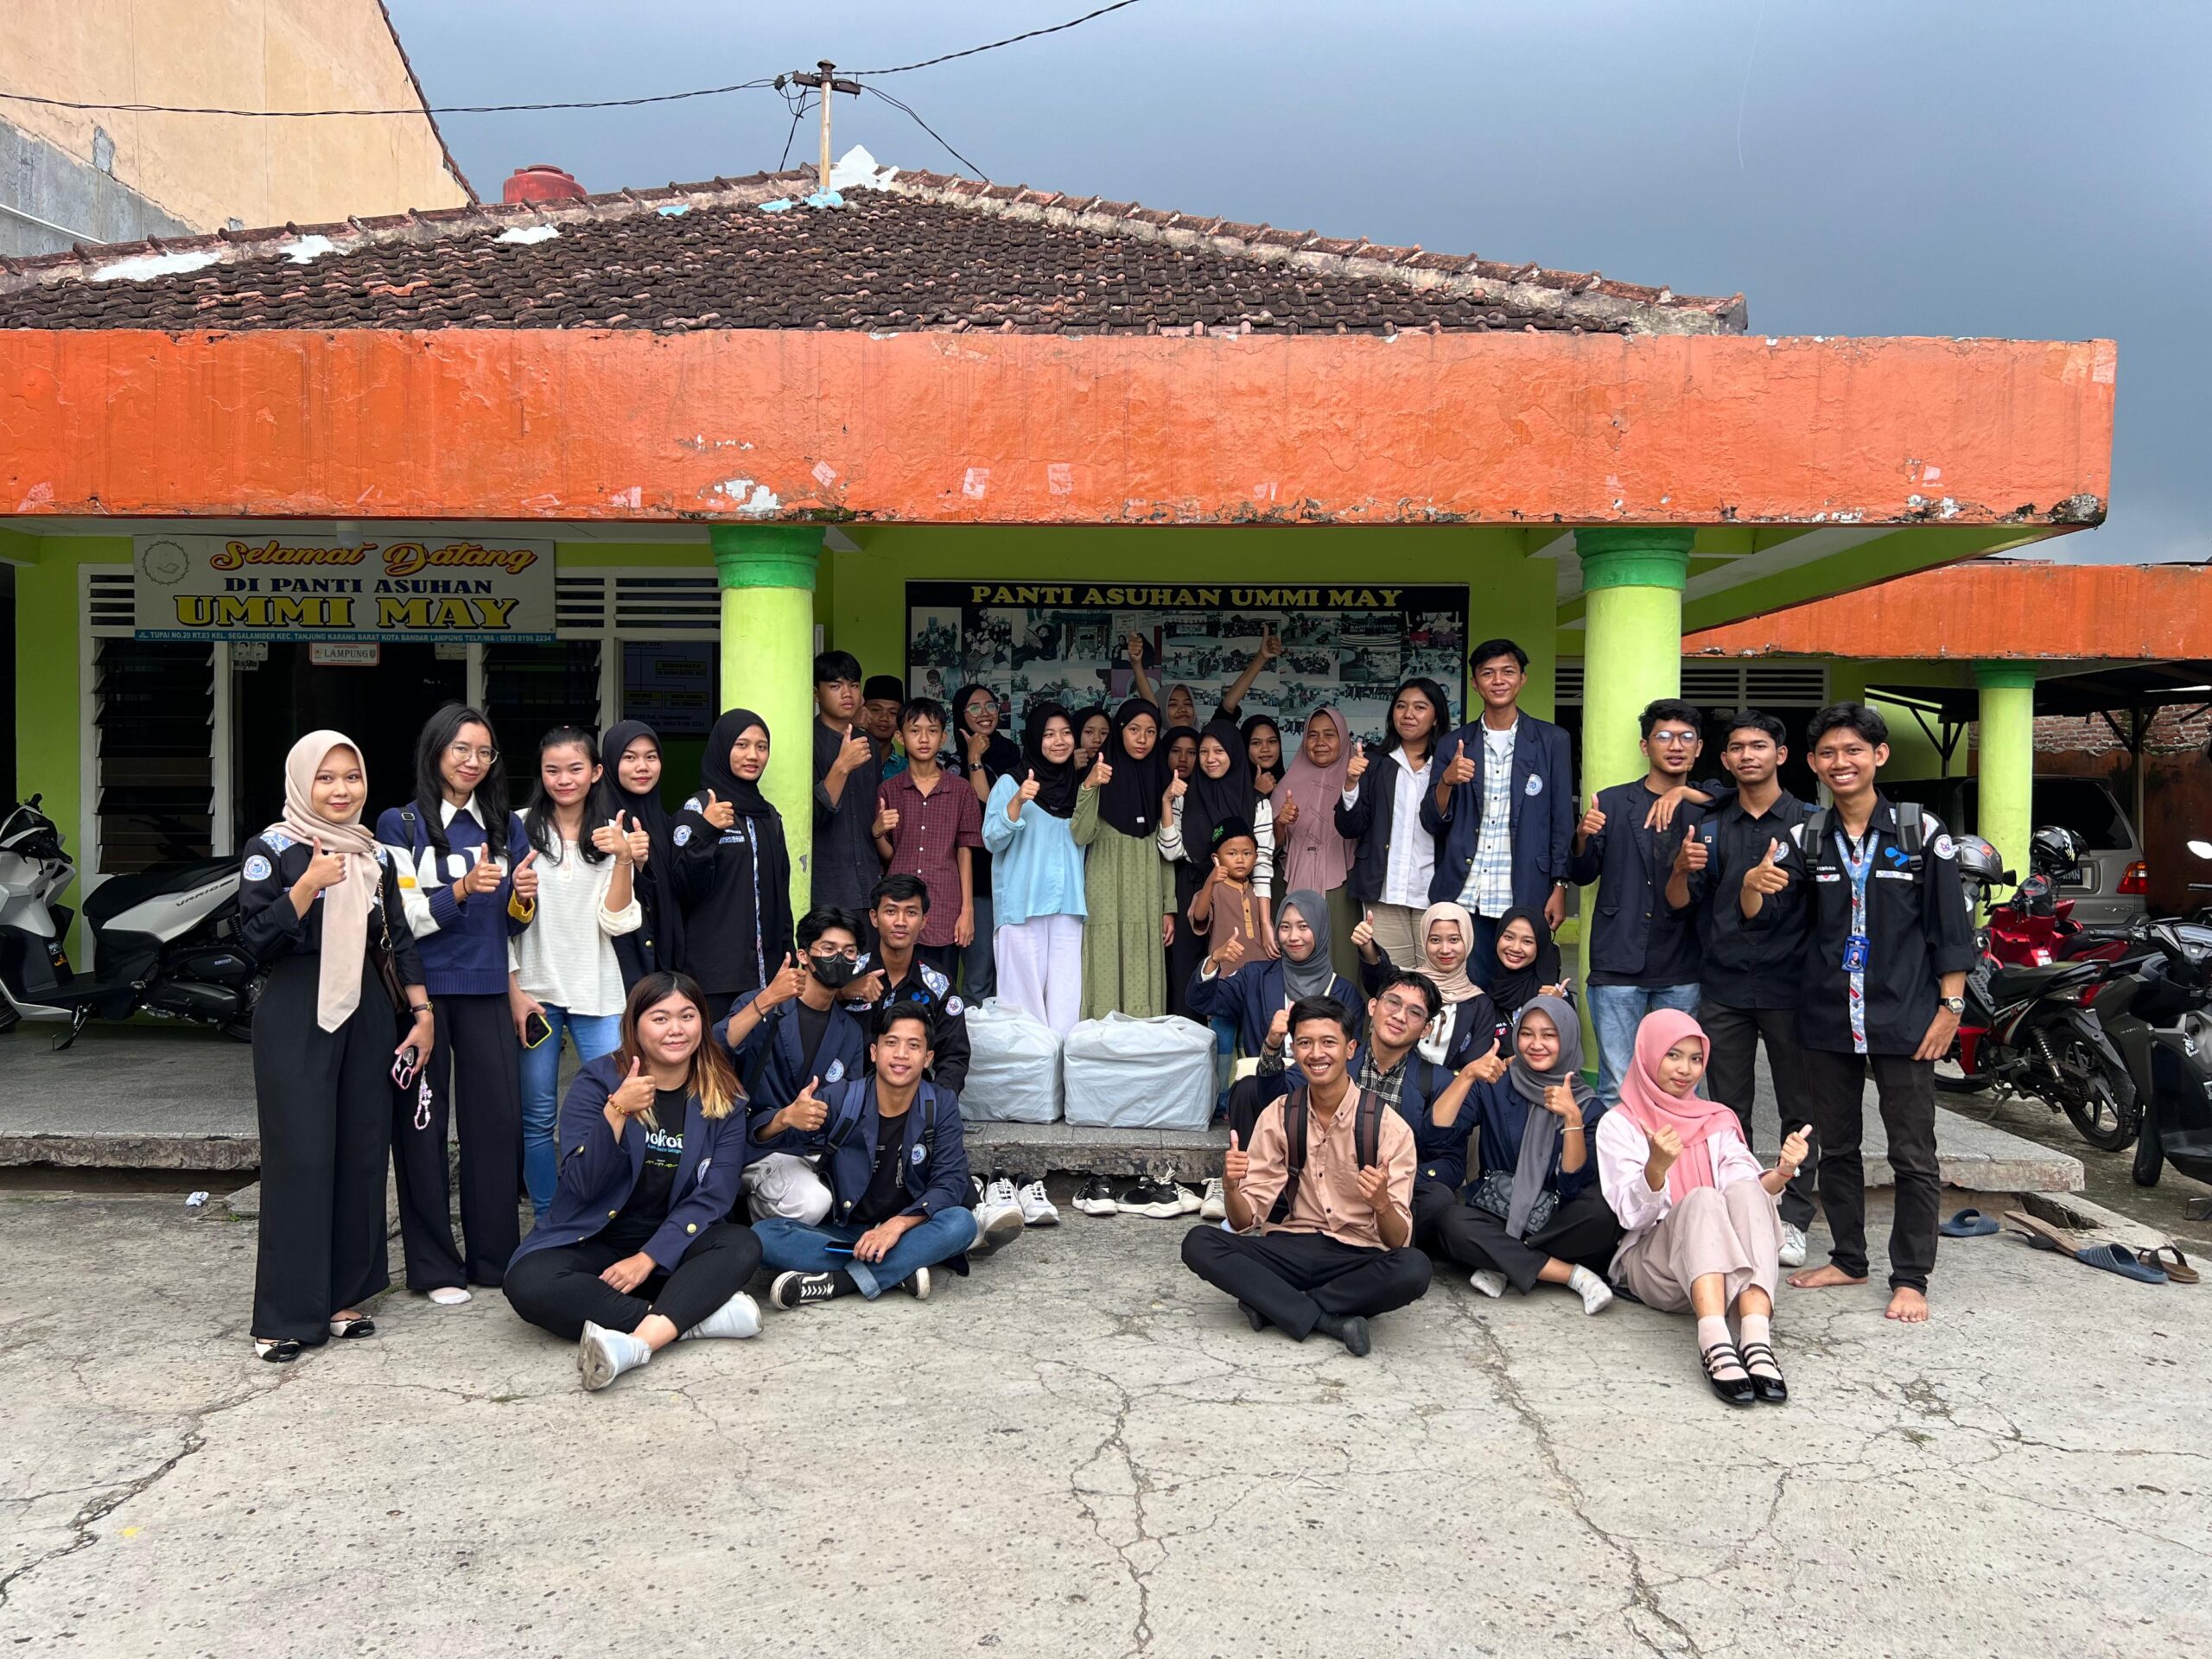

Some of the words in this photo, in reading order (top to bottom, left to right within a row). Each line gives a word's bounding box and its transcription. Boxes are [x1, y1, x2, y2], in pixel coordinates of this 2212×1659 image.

[210, 540, 378, 571] Selamat
[382, 542, 538, 577] Datang
[224, 578, 260, 592] DI
[270, 578, 363, 593] PANTI
[373, 579, 493, 594] ASUHAN
[971, 586, 1073, 604] PANTI
[1081, 588, 1222, 606] ASUHAN
[1230, 589, 1319, 607] UMMI
[1327, 590, 1403, 607] MAY
[173, 595, 356, 628] UMMI
[375, 597, 520, 630] MAY
[324, 649, 369, 658] LAMPUNG
